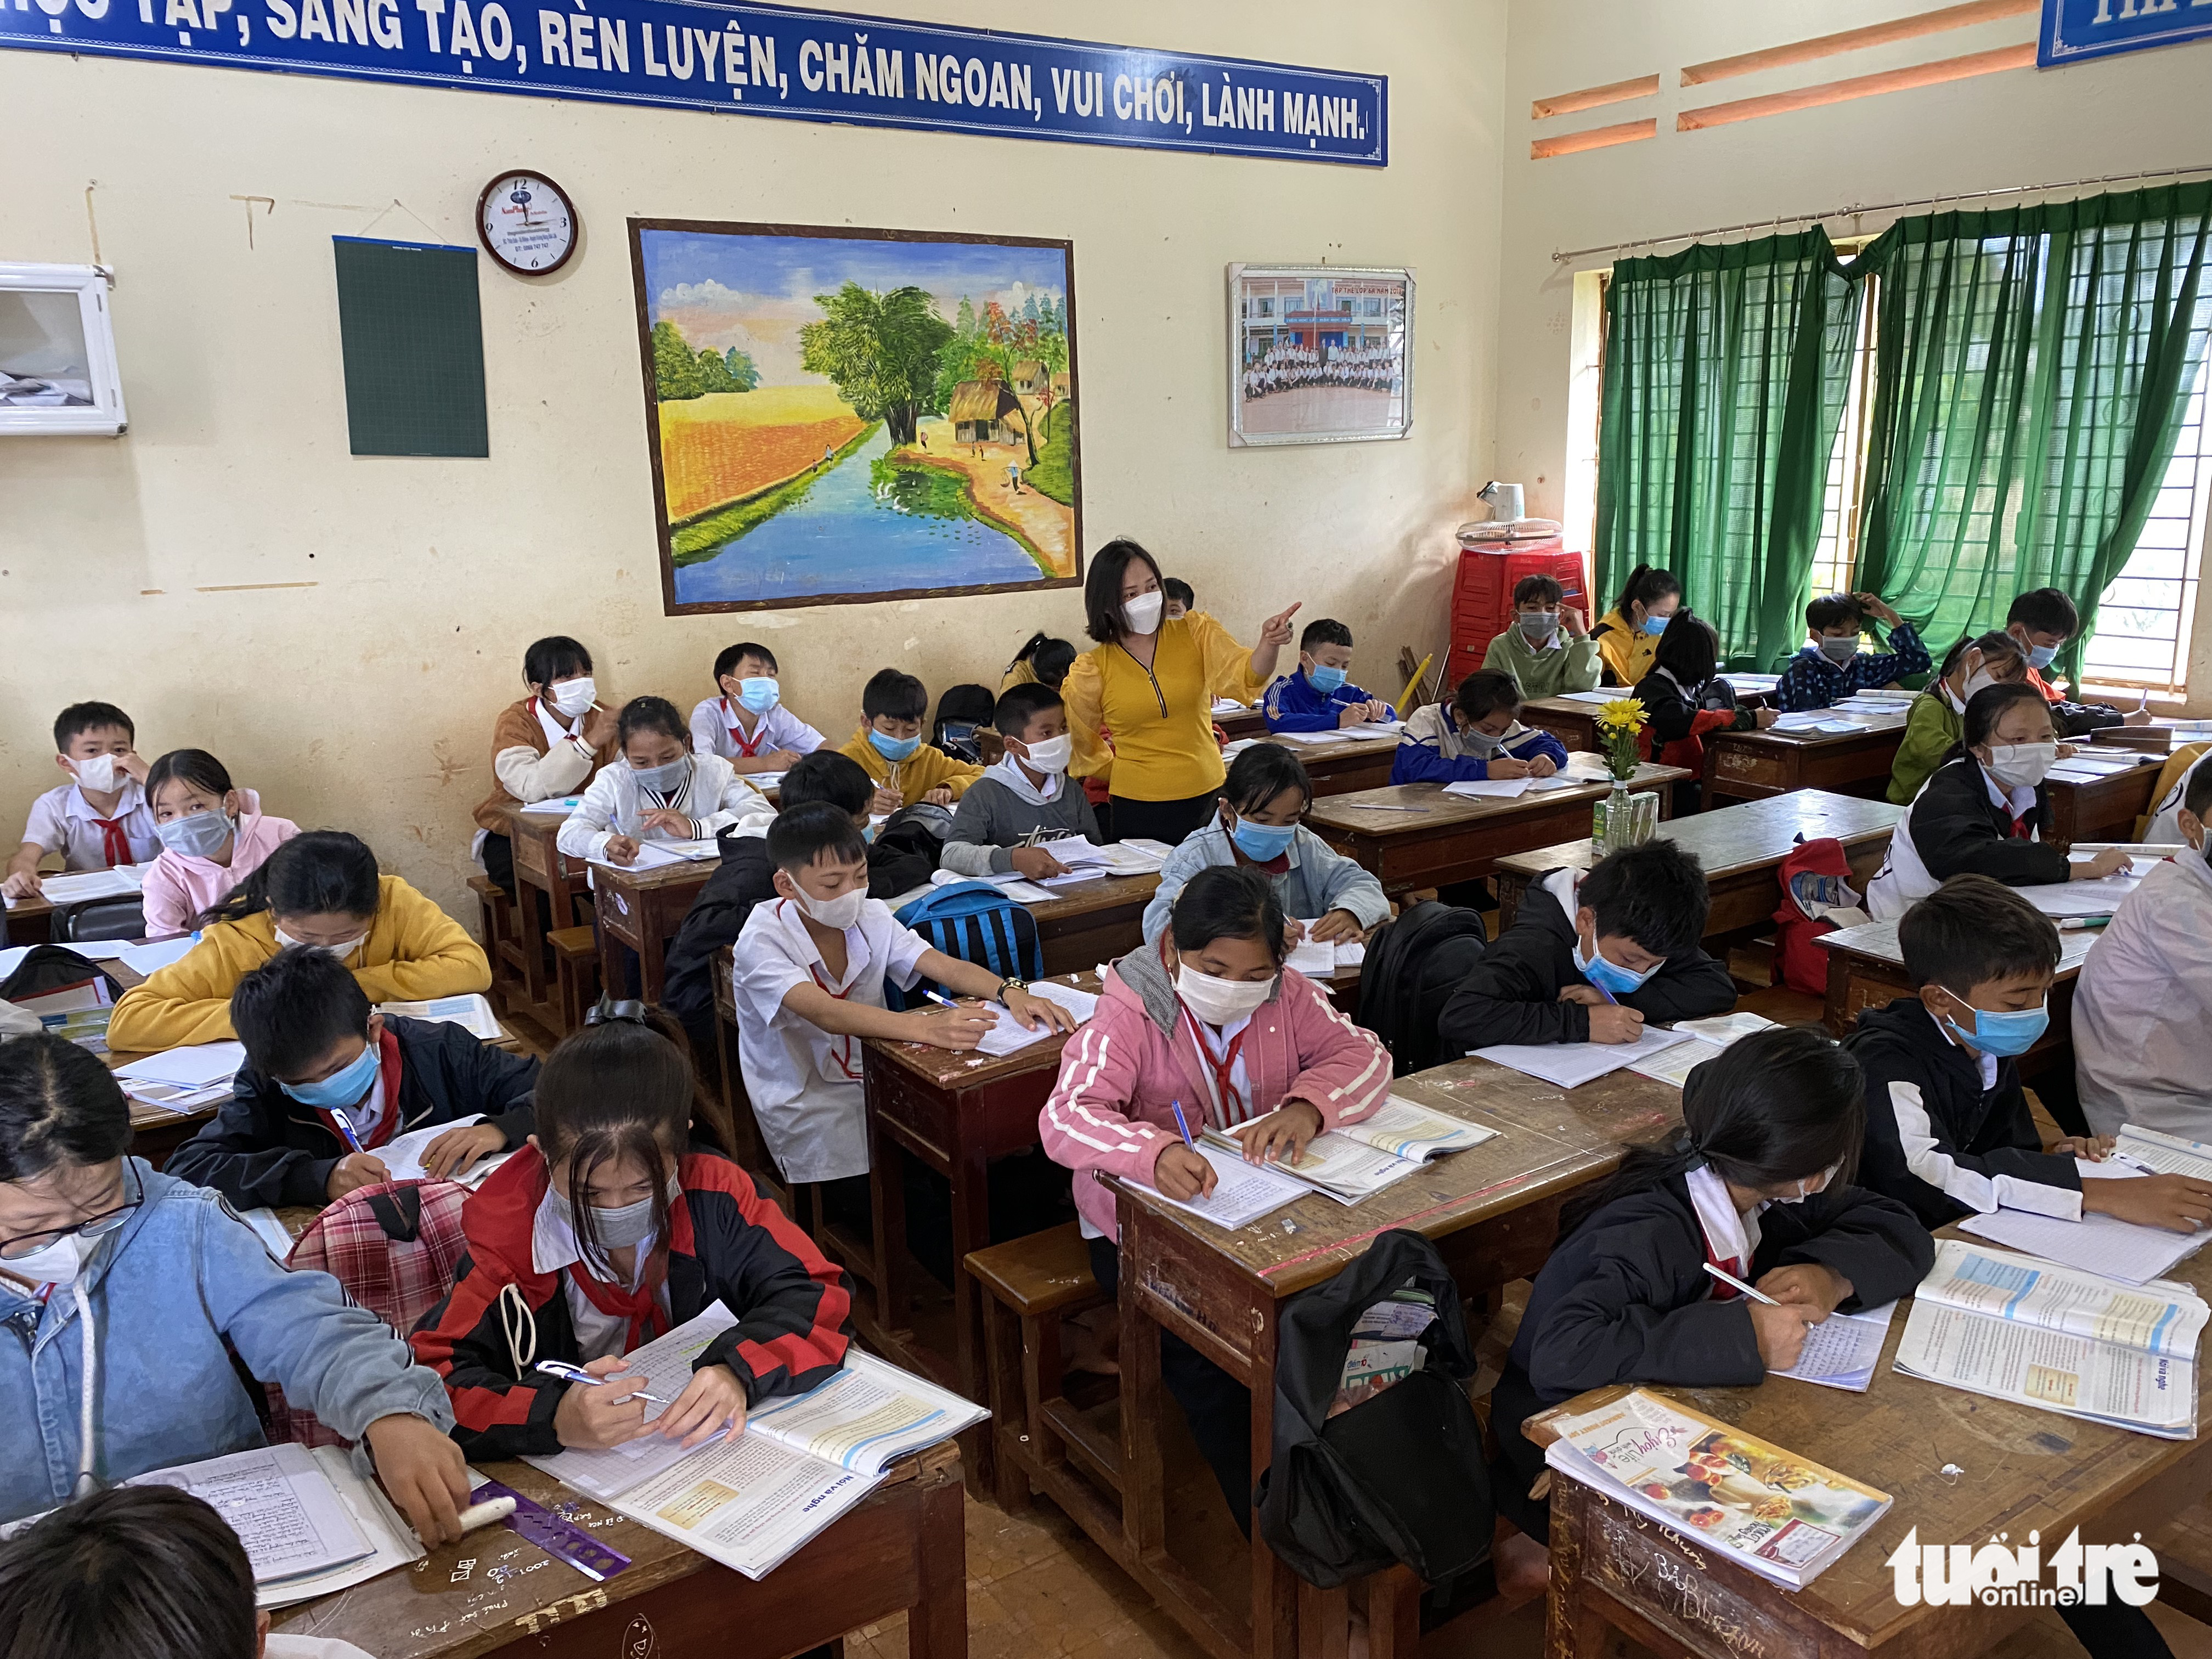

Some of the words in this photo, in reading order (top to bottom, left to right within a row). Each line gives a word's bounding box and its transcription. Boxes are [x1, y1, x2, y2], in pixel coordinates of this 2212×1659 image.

[426, 1, 527, 74] TẠO,
[540, 0, 629, 74] RÈN
[644, 20, 788, 101] LUYỆN,
[799, 32, 904, 99] CHĂM
[915, 53, 1042, 122] NGOAN,
[1051, 67, 1103, 117] VUI
[1201, 71, 1274, 133] LÀNH
[1283, 92, 1365, 149] MẠNH.
[514, 178, 527, 190] 12
[486, 223, 493, 235] 9
[560, 217, 567, 228] 3
[531, 257, 539, 268] 6
[1630, 1427, 1677, 1454] Enjoy
[1618, 1449, 1644, 1463] Life
[837, 1475, 854, 1486] Nói
[825, 1485, 838, 1495] và
[802, 1494, 827, 1513] nghe
